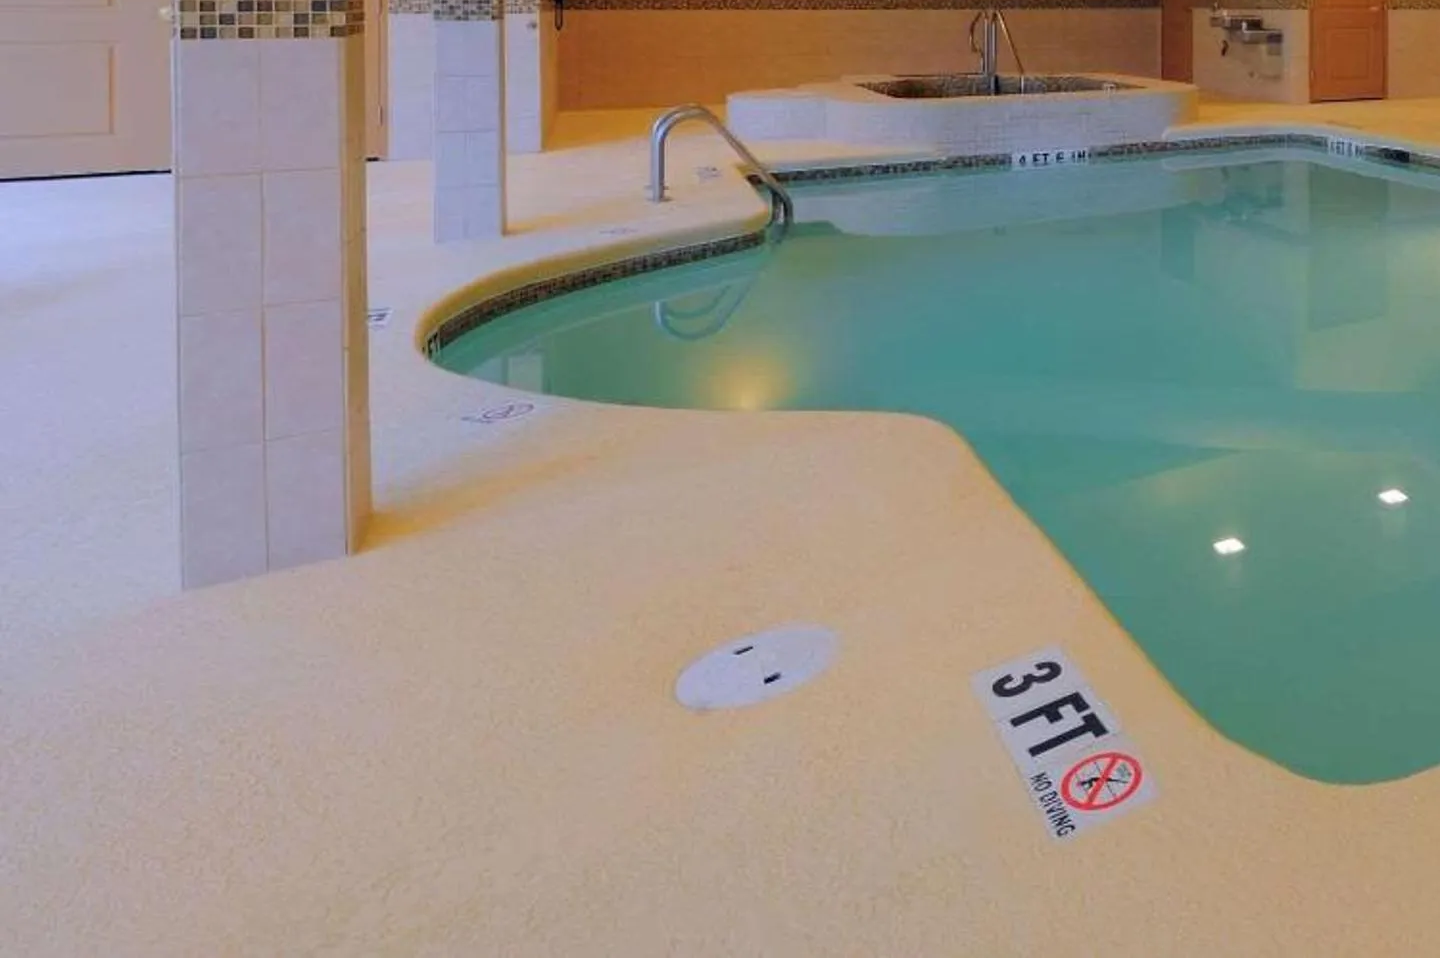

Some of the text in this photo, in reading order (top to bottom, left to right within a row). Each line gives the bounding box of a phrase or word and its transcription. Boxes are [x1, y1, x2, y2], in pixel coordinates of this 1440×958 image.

[1032, 152, 1050, 164] FT
[991, 660, 1110, 758] 3 FT
[1029, 771, 1076, 837] NO DIVING
